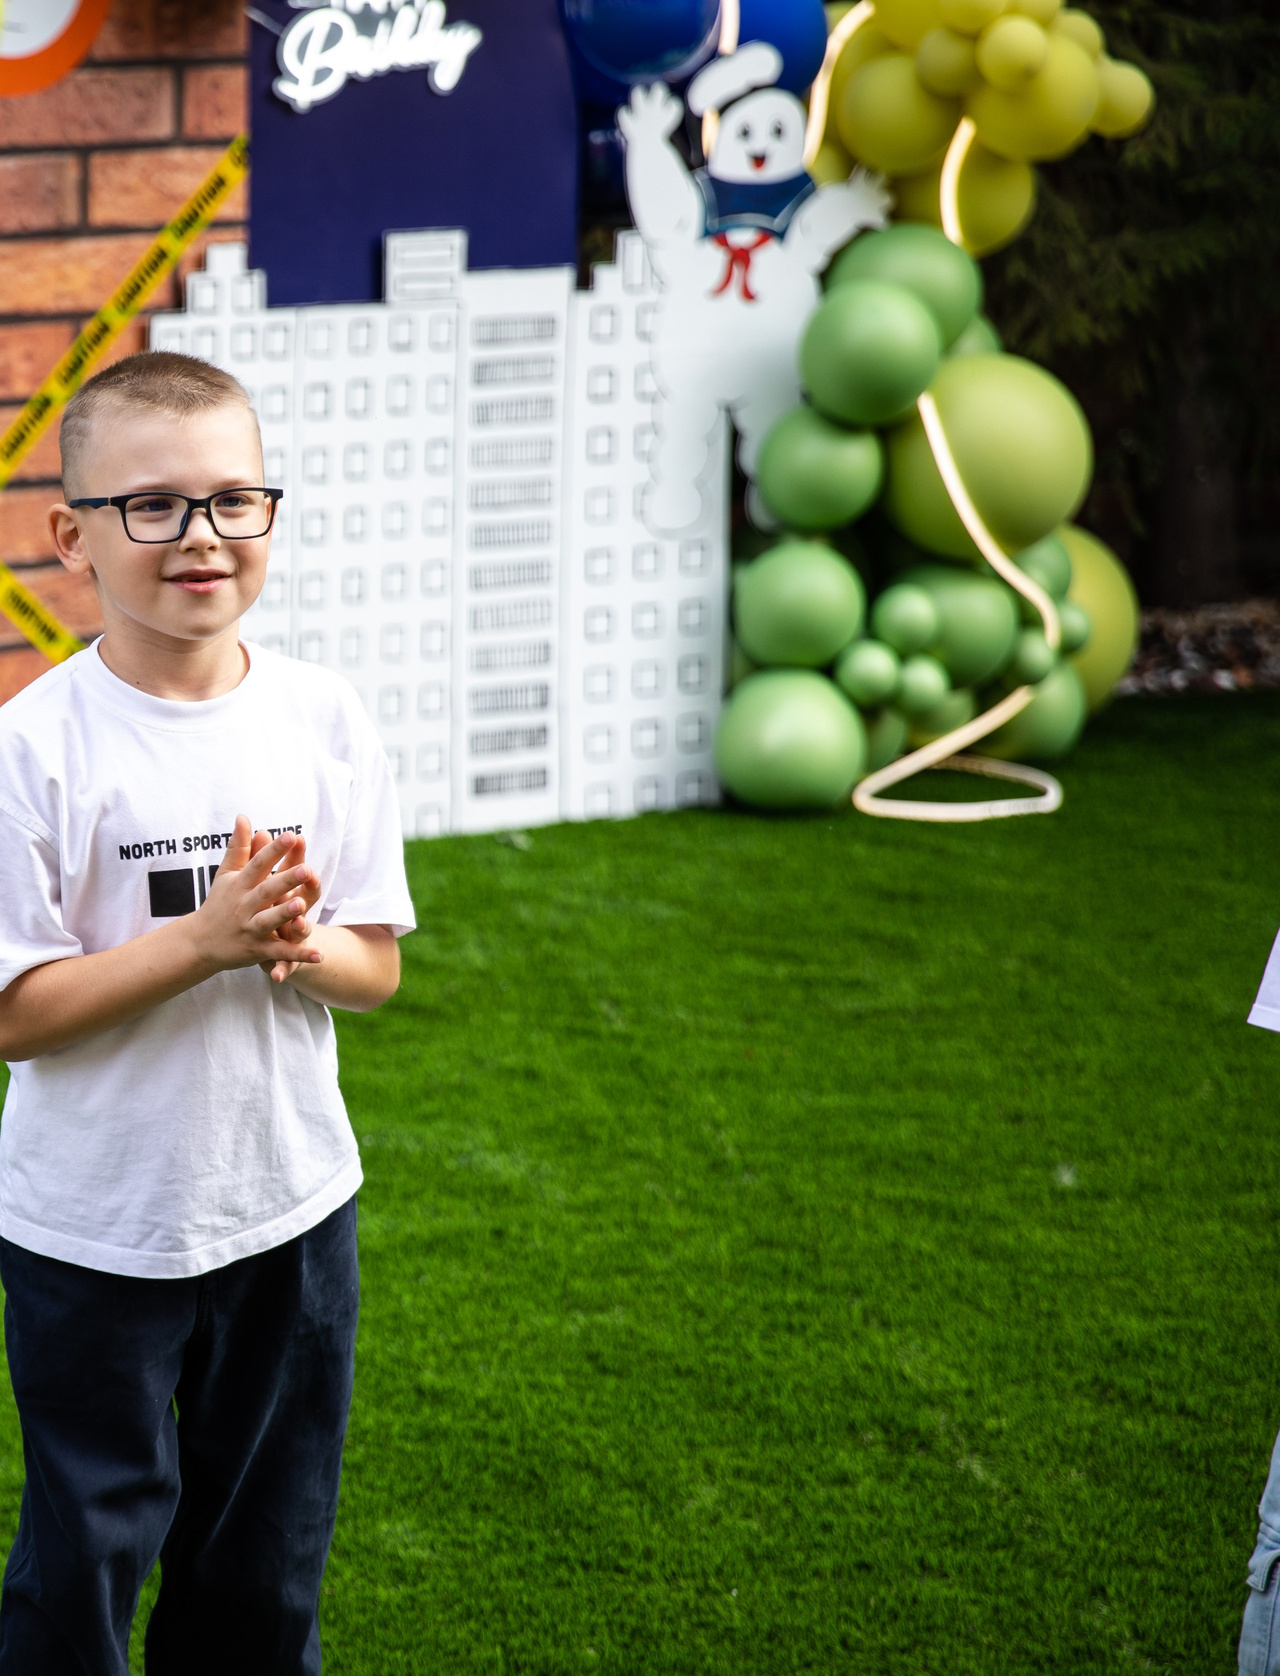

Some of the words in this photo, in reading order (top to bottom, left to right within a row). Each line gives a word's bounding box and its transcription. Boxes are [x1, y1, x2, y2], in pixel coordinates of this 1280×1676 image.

[57, 320, 110, 387] CAUTION
[114, 245, 168, 314] CAUTION
[172, 173, 227, 240] CAUTION
[118, 838, 177, 860] NORTH
[182, 832, 233, 853] SPORT
